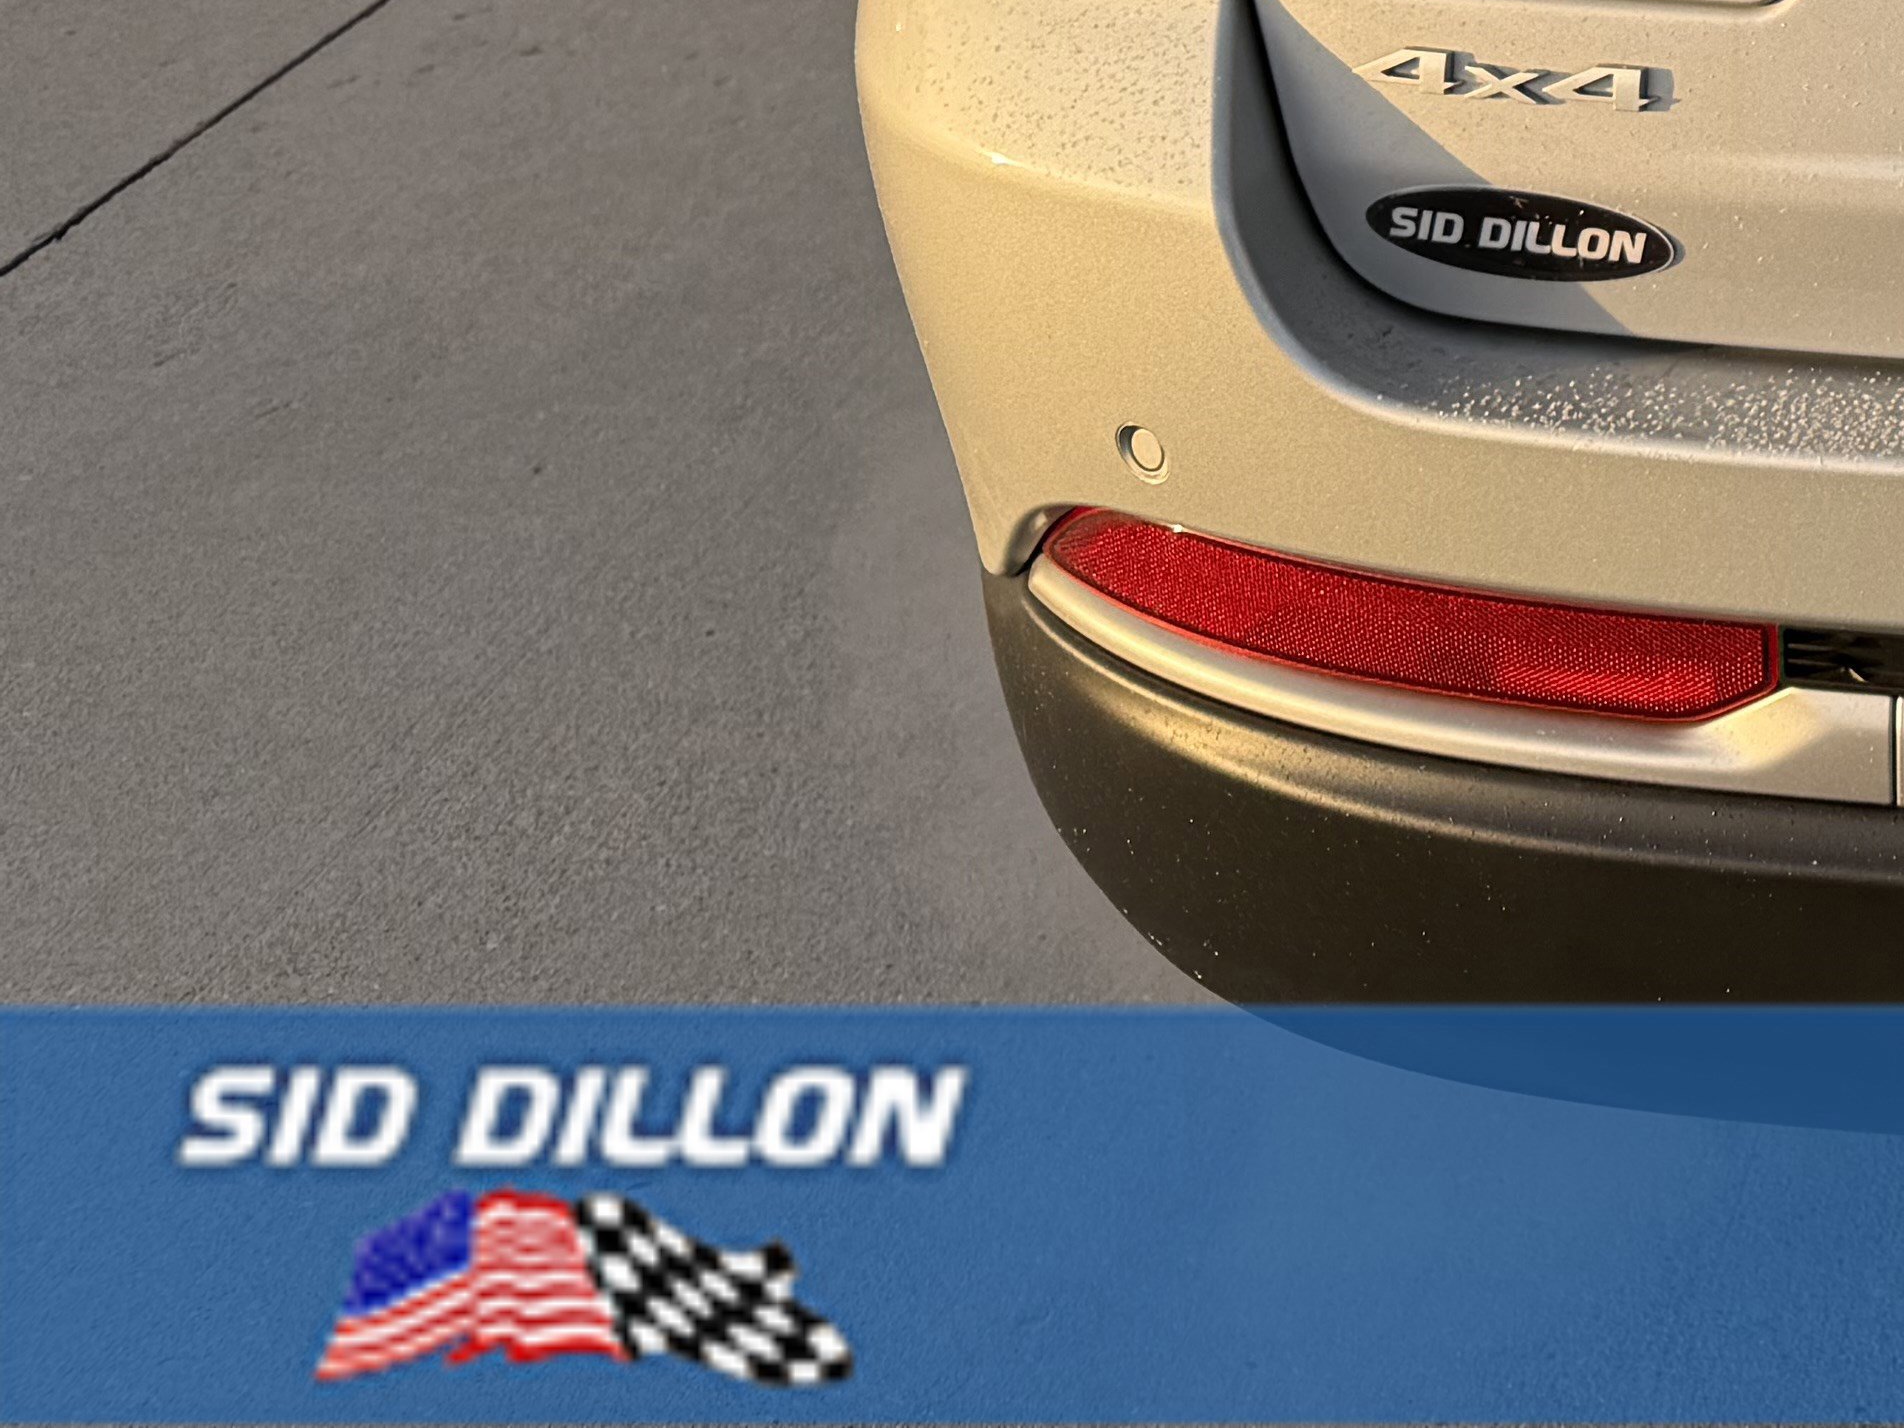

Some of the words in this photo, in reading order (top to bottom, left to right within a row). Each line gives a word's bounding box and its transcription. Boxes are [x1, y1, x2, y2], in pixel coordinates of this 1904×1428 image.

[1352, 46, 1662, 112] 4x4
[1389, 206, 1465, 245] SID
[1477, 217, 1648, 265] DILLON
